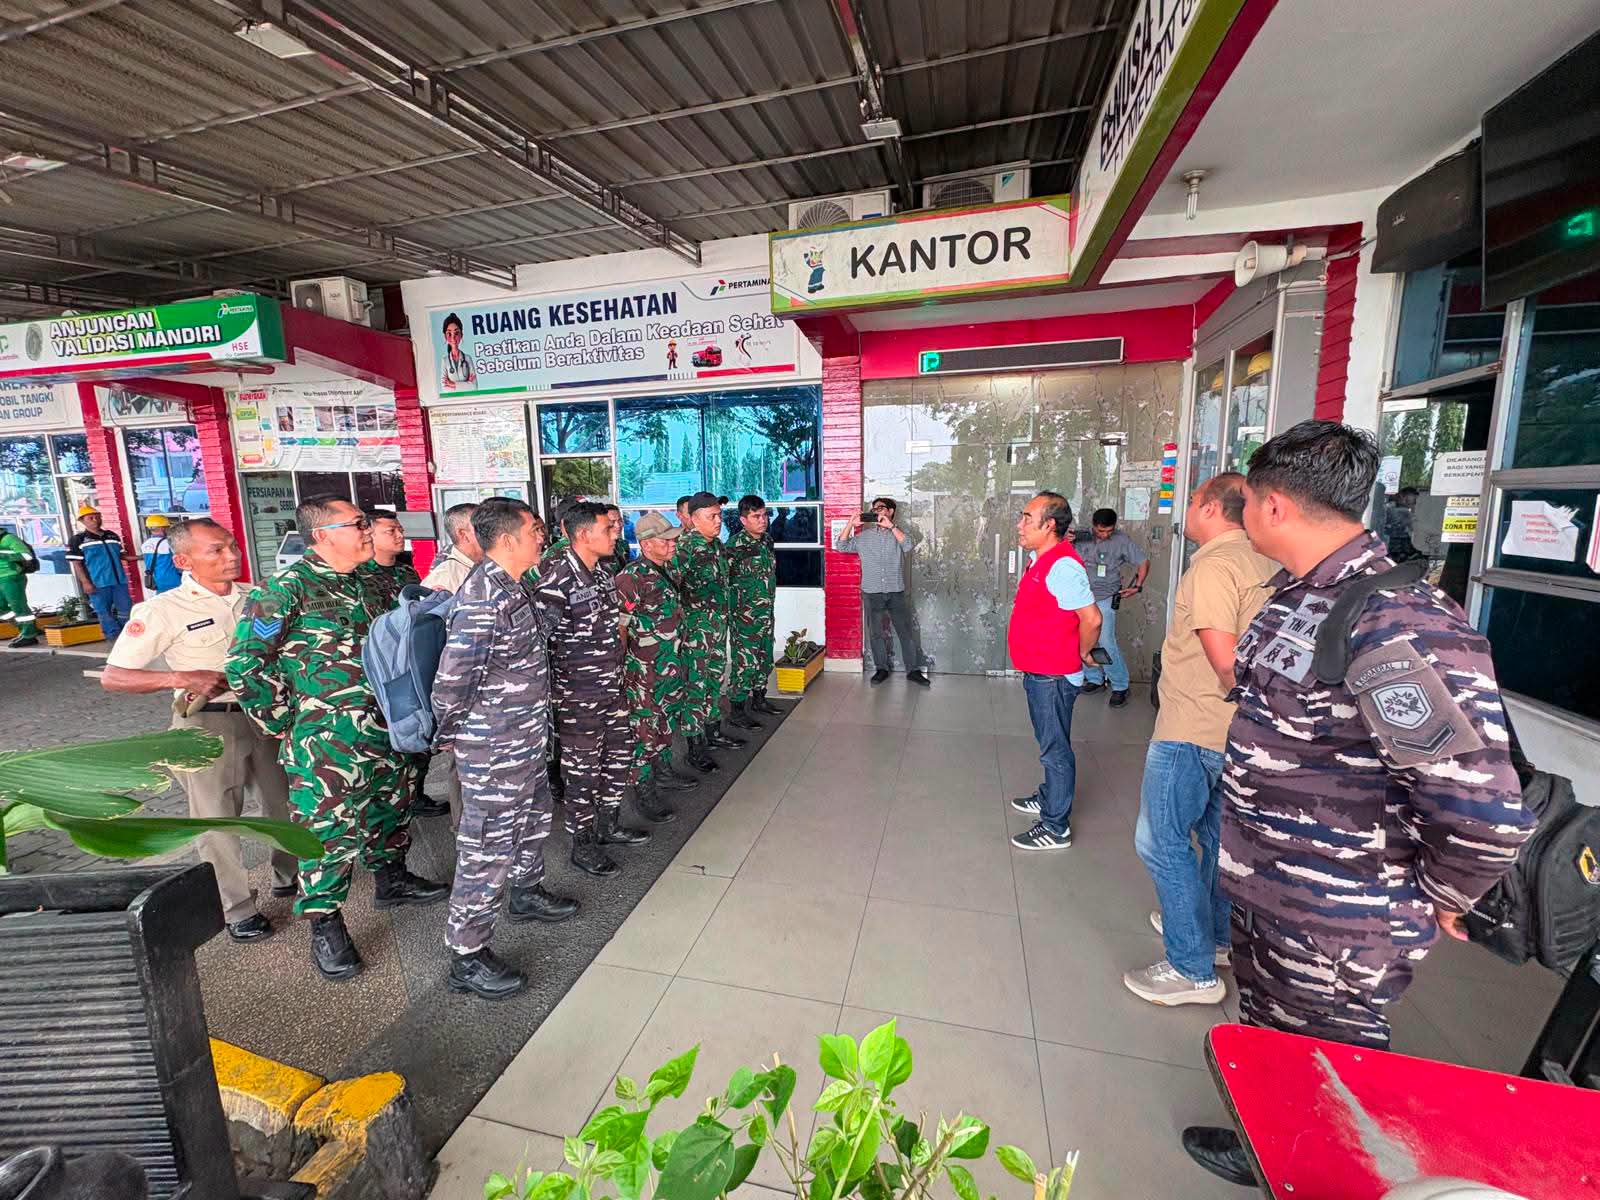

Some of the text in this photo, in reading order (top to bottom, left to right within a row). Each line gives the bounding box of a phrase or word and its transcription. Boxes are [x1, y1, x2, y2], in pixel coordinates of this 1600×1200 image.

[851, 226, 1031, 279] KANTOR
[50, 311, 154, 339] ANJUNGAN
[471, 291, 678, 335] RUANG KESEHATAN
[52, 324, 221, 357] VALIDASI MANDIRI
[232, 342, 249, 351] HSE
[474, 337, 540, 357] Pastikan
[544, 333, 585, 351] Anda
[589, 327, 642, 346] Dalam
[646, 319, 725, 341] Keadaan
[729, 313, 785, 332] Sehat
[476, 346, 645, 375] Sebelum Beraktivitas
[923, 351, 940, 372] P
[21, 391, 54, 404] TANGKI
[13, 406, 43, 419] GROUP
[247, 487, 284, 498] PERSIAPAN
[1288, 617, 1307, 633] TNI
